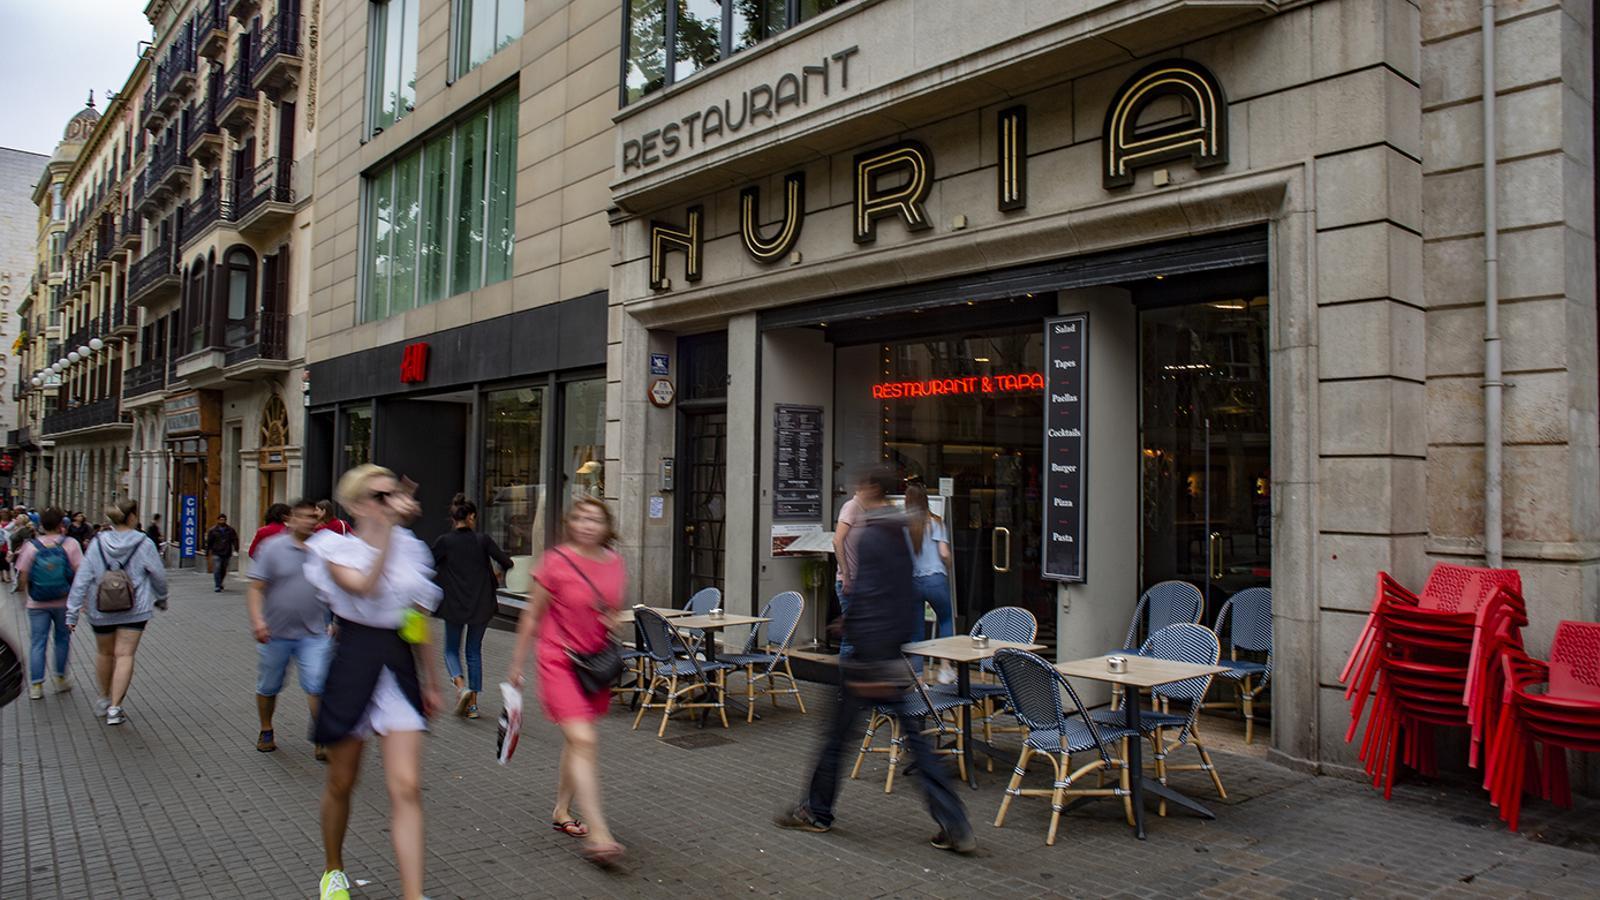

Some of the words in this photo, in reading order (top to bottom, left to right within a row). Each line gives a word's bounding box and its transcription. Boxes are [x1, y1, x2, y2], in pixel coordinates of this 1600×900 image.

[623, 45, 858, 173] RESTAURANT
[649, 57, 1229, 291] NURIA
[1055, 323, 1076, 334] Salad
[1054, 359, 1076, 369] Tapes
[872, 376, 978, 398] RESTAURANT
[981, 376, 993, 392] &
[1052, 393, 1078, 403] Paellas
[1048, 428, 1081, 438] Cocktails
[1051, 463, 1077, 474] Burger
[1053, 497, 1073, 507] Pizza
[185, 497, 195, 556] CHANGE
[1052, 532, 1073, 542] Pasta
